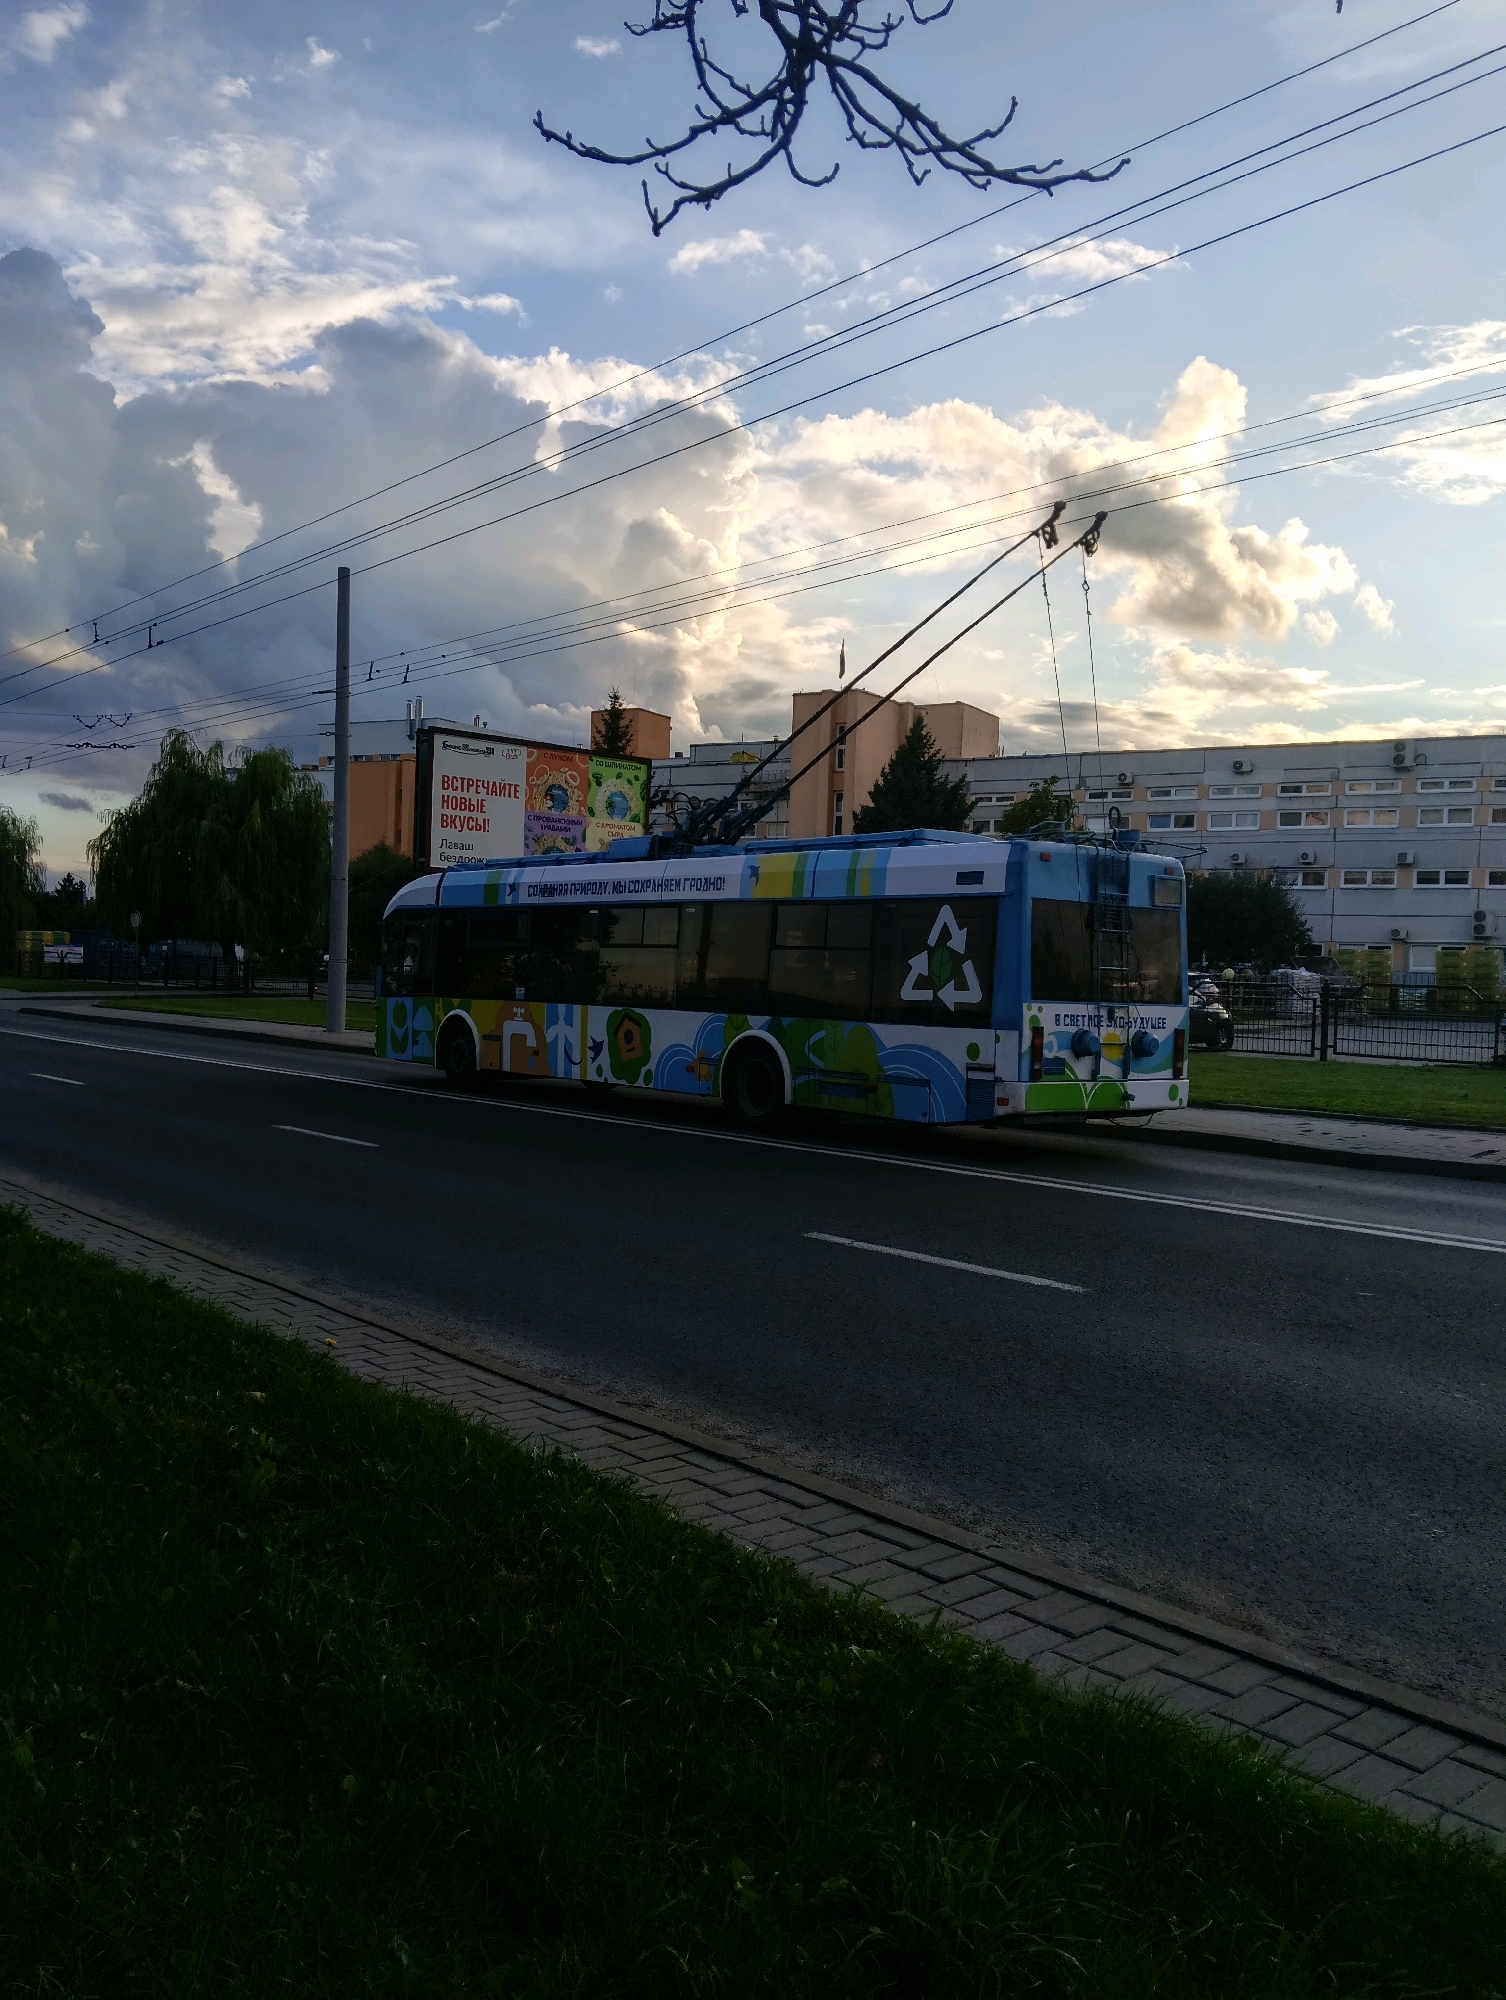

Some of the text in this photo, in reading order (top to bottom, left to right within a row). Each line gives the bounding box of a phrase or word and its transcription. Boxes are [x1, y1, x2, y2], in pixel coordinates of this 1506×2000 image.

[549, 753, 573, 763] ЛУКОМ
[595, 759, 642, 772] СО ШПИНАТОМ
[441, 774, 520, 800] ВСТРЕЧАЙТЕ
[441, 794, 487, 814] НОВЫЕ
[440, 813, 490, 833] ВКУСЫ!
[533, 815, 583, 827] ПРОВАНСКИМИ
[600, 822, 636, 832] АРОМАТОМ
[540, 823, 571, 833] ТРАВАМИ
[439, 838, 474, 851] Лаваш
[569, 881, 611, 896] ПРИРОДУ,
[612, 880, 627, 895] МЫ
[627, 878, 681, 894] СОХРАНЯЕМ
[682, 876, 726, 893] ГРОДНО!
[1054, 1013, 1061, 1027] В
